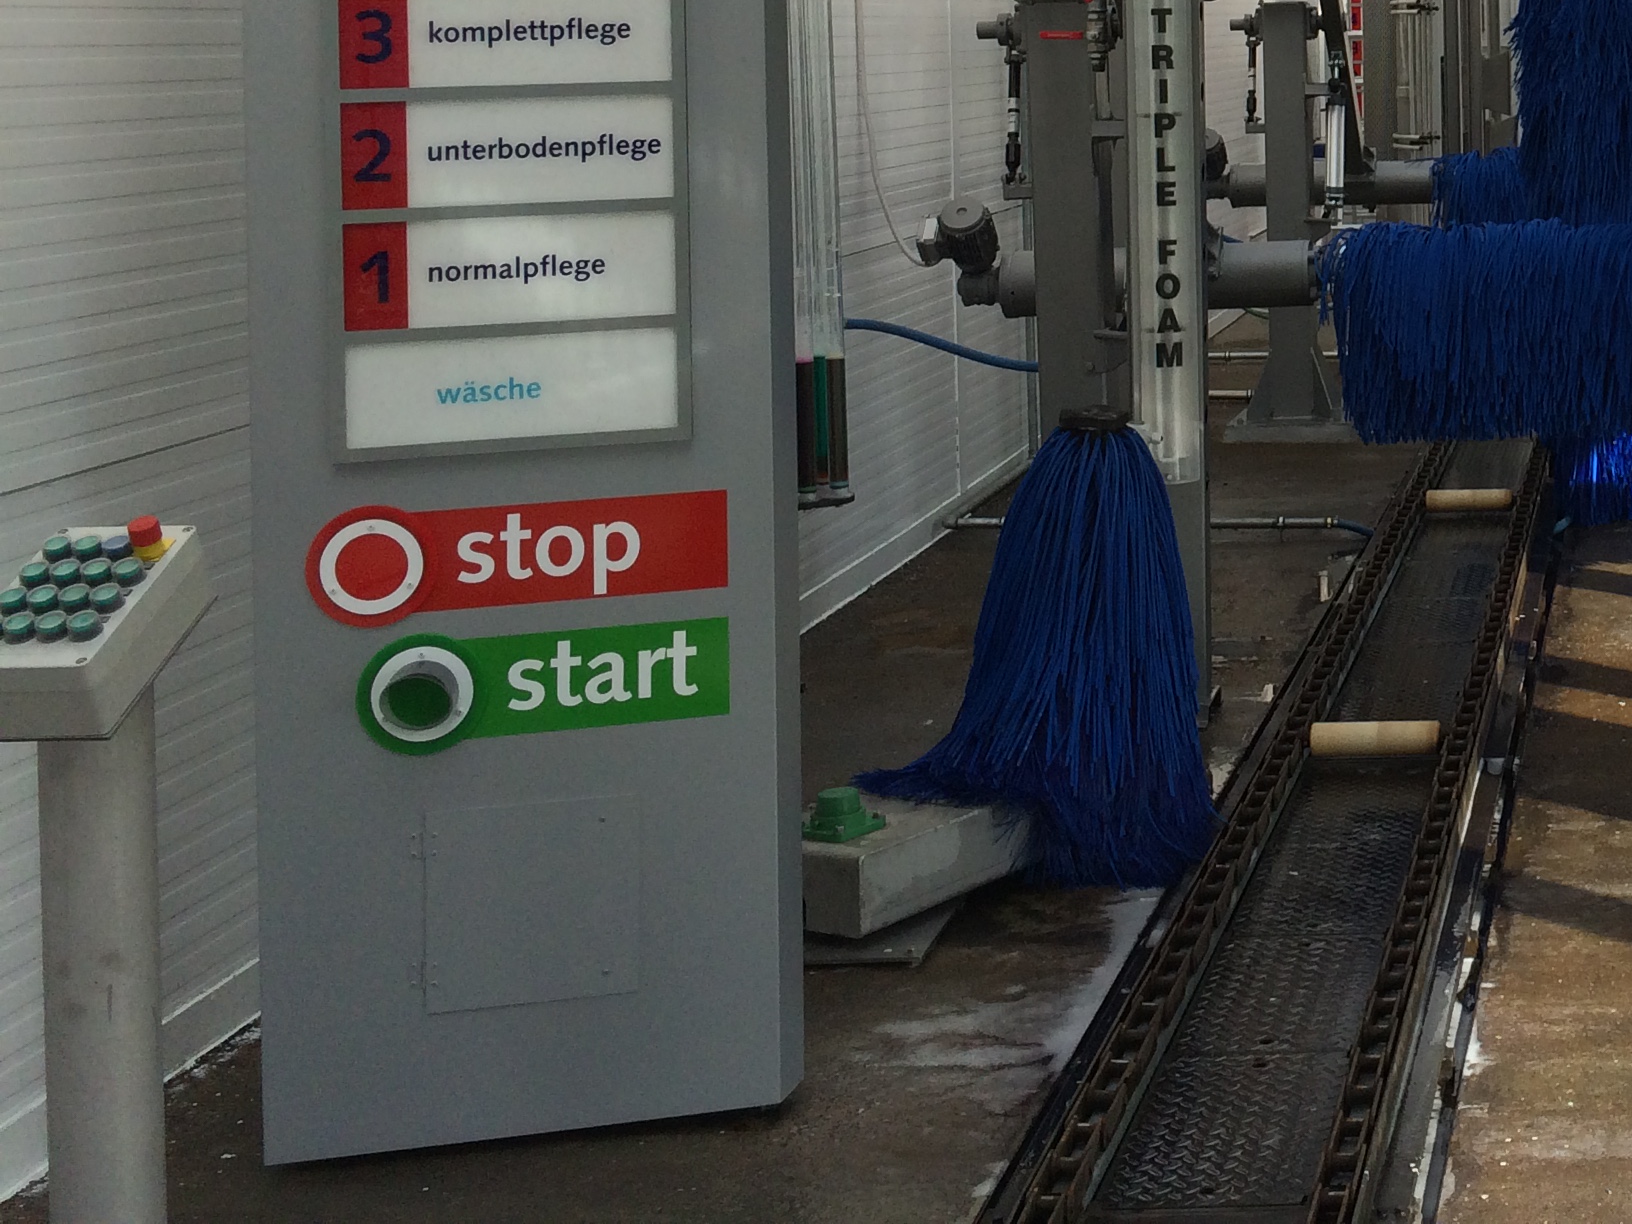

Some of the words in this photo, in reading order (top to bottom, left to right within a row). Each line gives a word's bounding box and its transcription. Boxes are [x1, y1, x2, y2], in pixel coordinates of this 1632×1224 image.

[354, 10, 393, 64] 3
[428, 19, 631, 49] komplettpflege
[1151, 8, 1177, 207] TRIPLE
[352, 129, 392, 183] 2
[427, 134, 662, 163] unterbodenpflege
[360, 250, 390, 304] 1
[427, 254, 606, 283] normalpflege
[1155, 239, 1183, 368] FOAM
[436, 377, 542, 405] wäsche
[457, 512, 641, 595] stop
[507, 630, 698, 712] start
